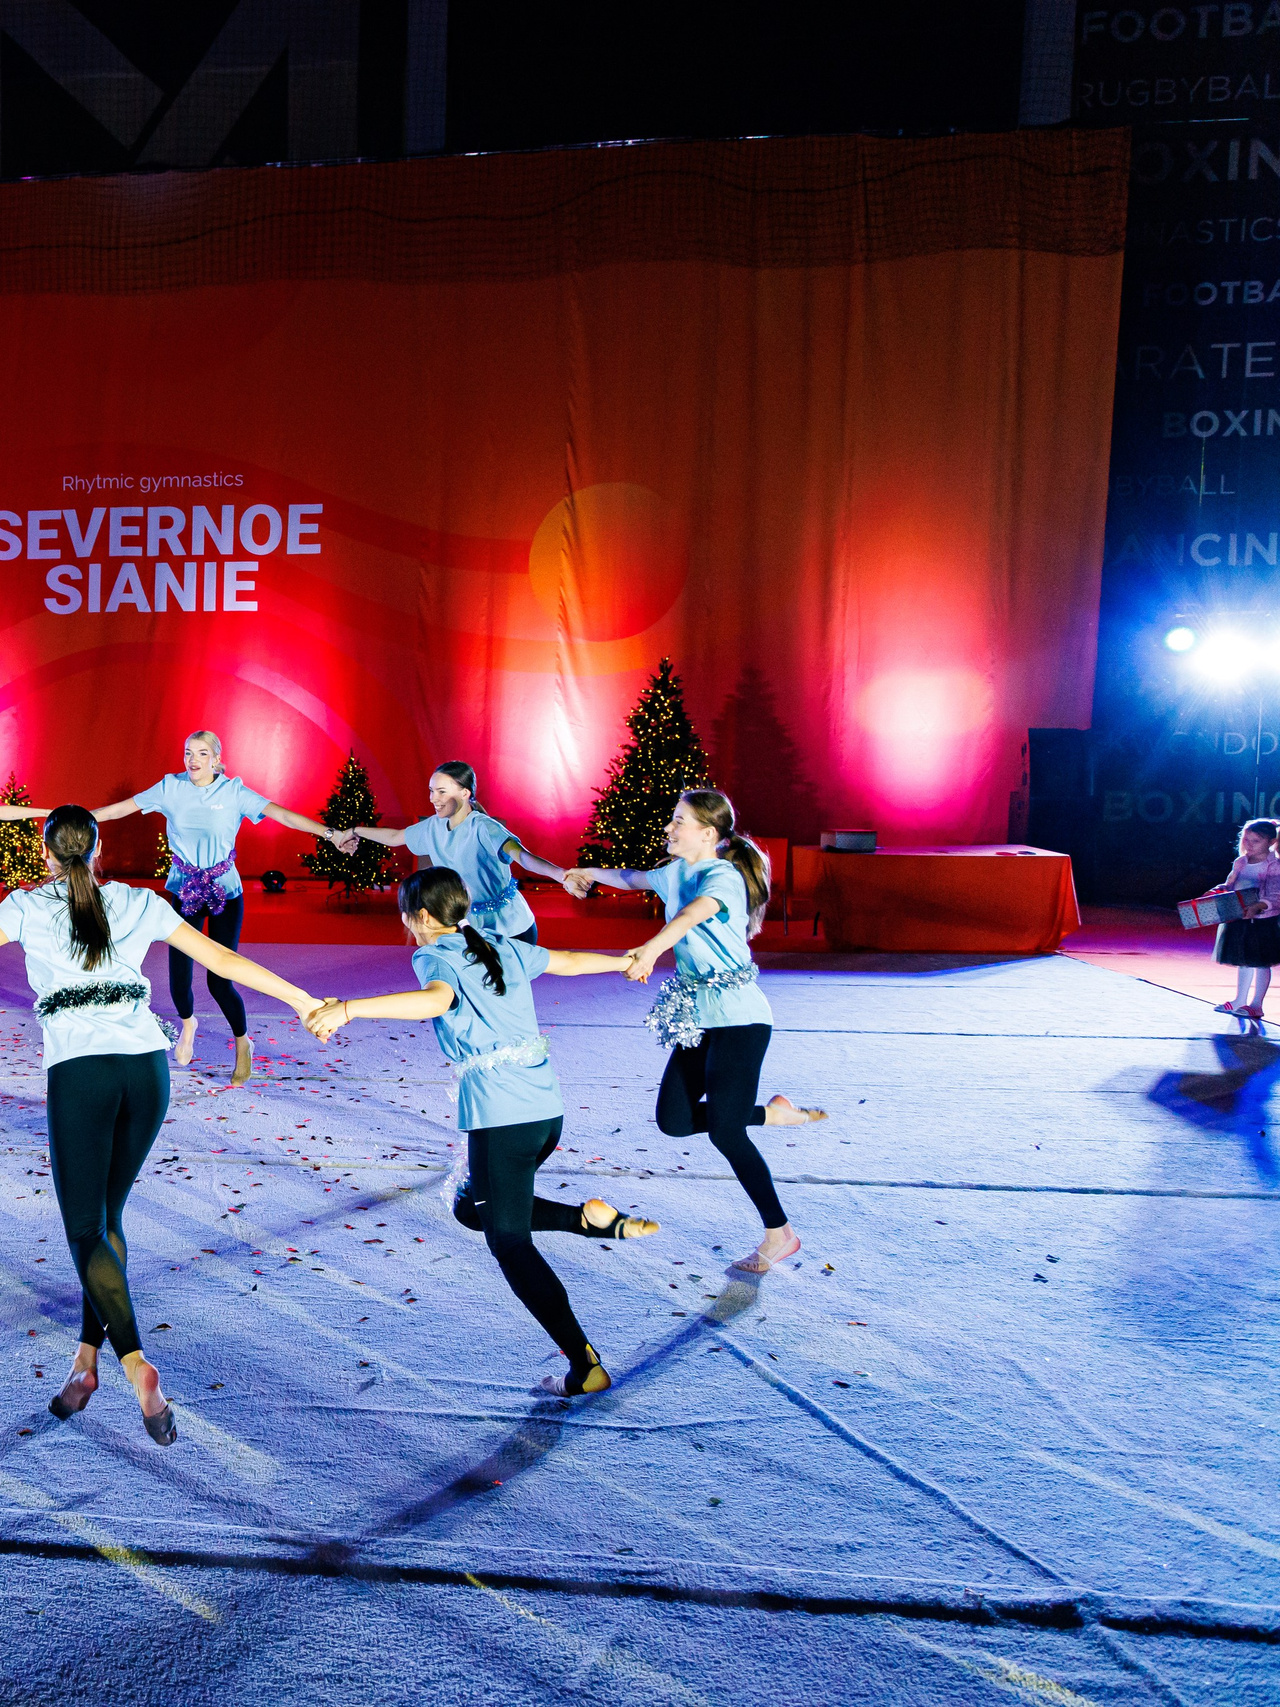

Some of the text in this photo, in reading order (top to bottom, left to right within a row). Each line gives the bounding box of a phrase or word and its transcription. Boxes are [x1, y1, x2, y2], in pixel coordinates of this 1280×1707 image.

[1120, 341, 1277, 380] RATE
[62, 471, 244, 493] Rhytmic gymnastics
[44, 561, 259, 615] SIANIE
